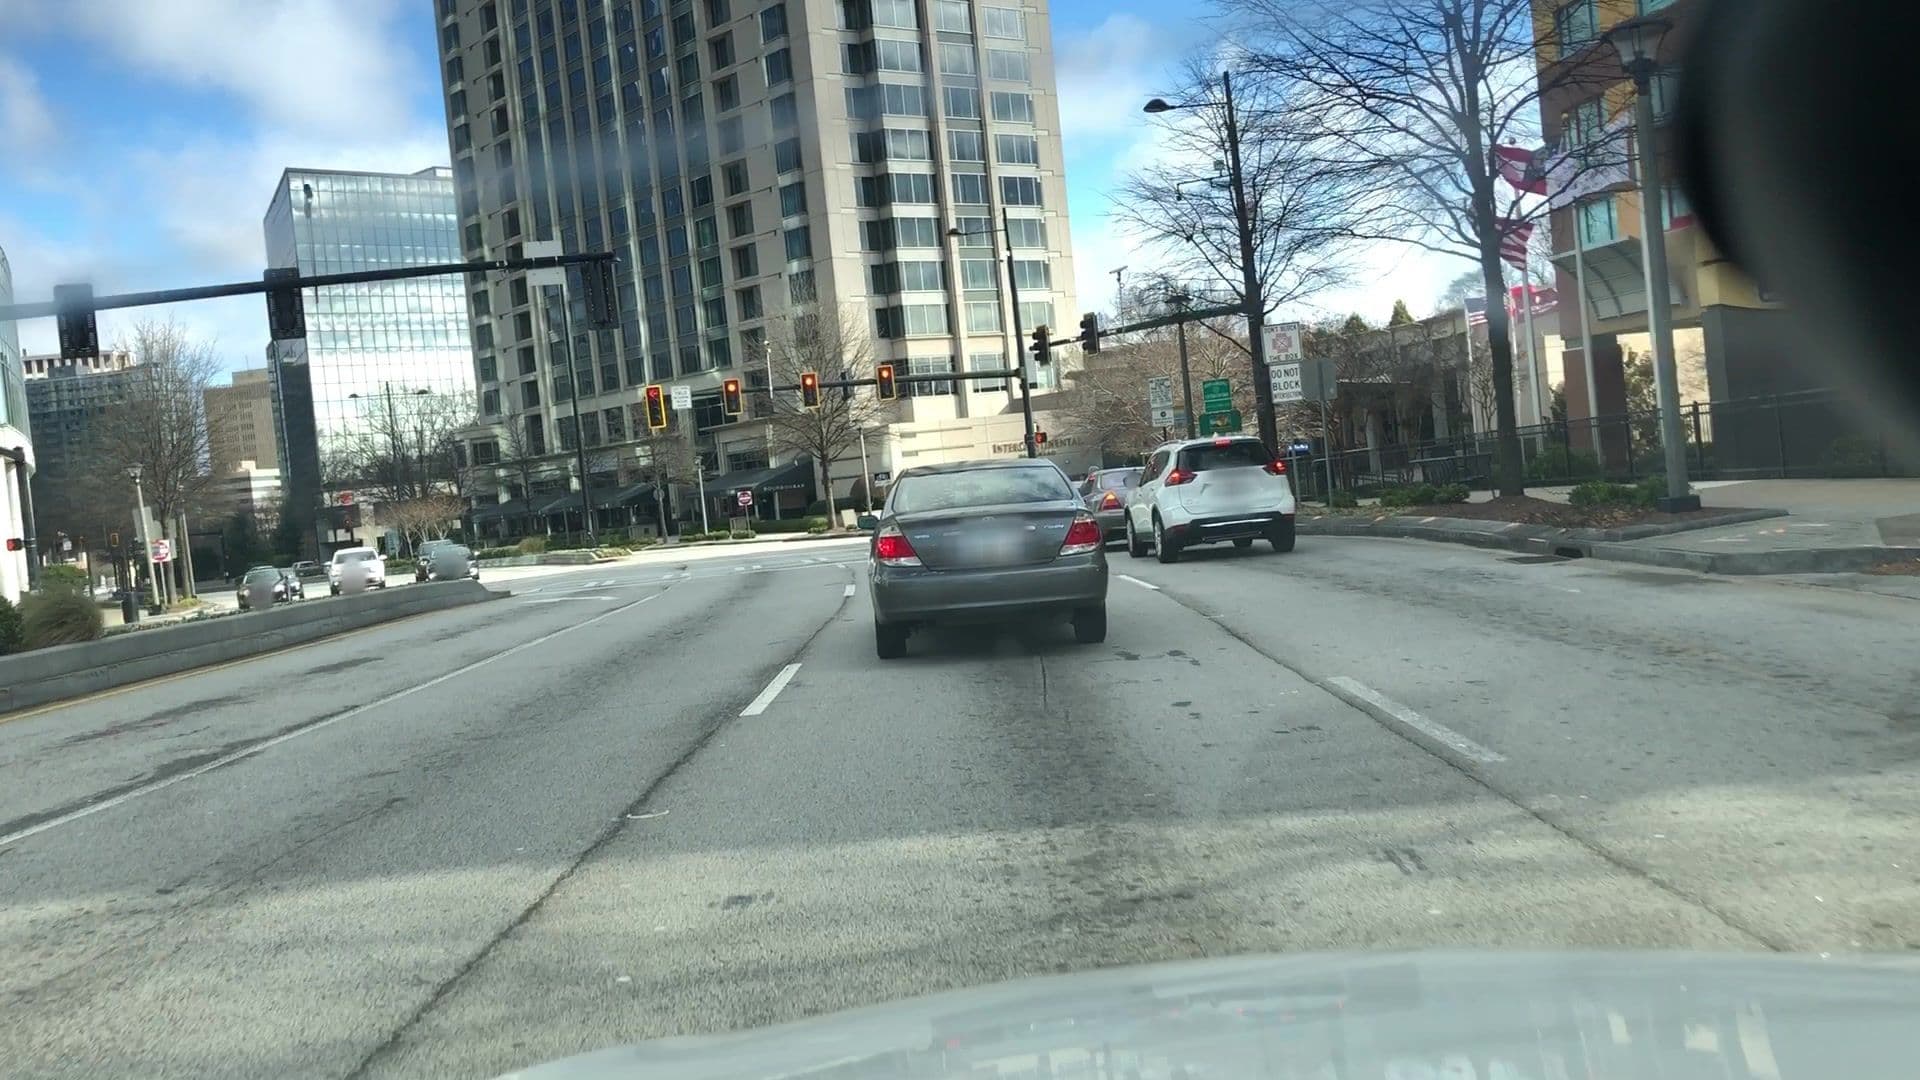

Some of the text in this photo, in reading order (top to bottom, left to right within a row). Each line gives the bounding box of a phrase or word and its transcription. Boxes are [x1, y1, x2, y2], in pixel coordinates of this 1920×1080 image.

[1271, 367, 1299, 379] DO NOT
[1272, 381, 1301, 391] BLOCK
